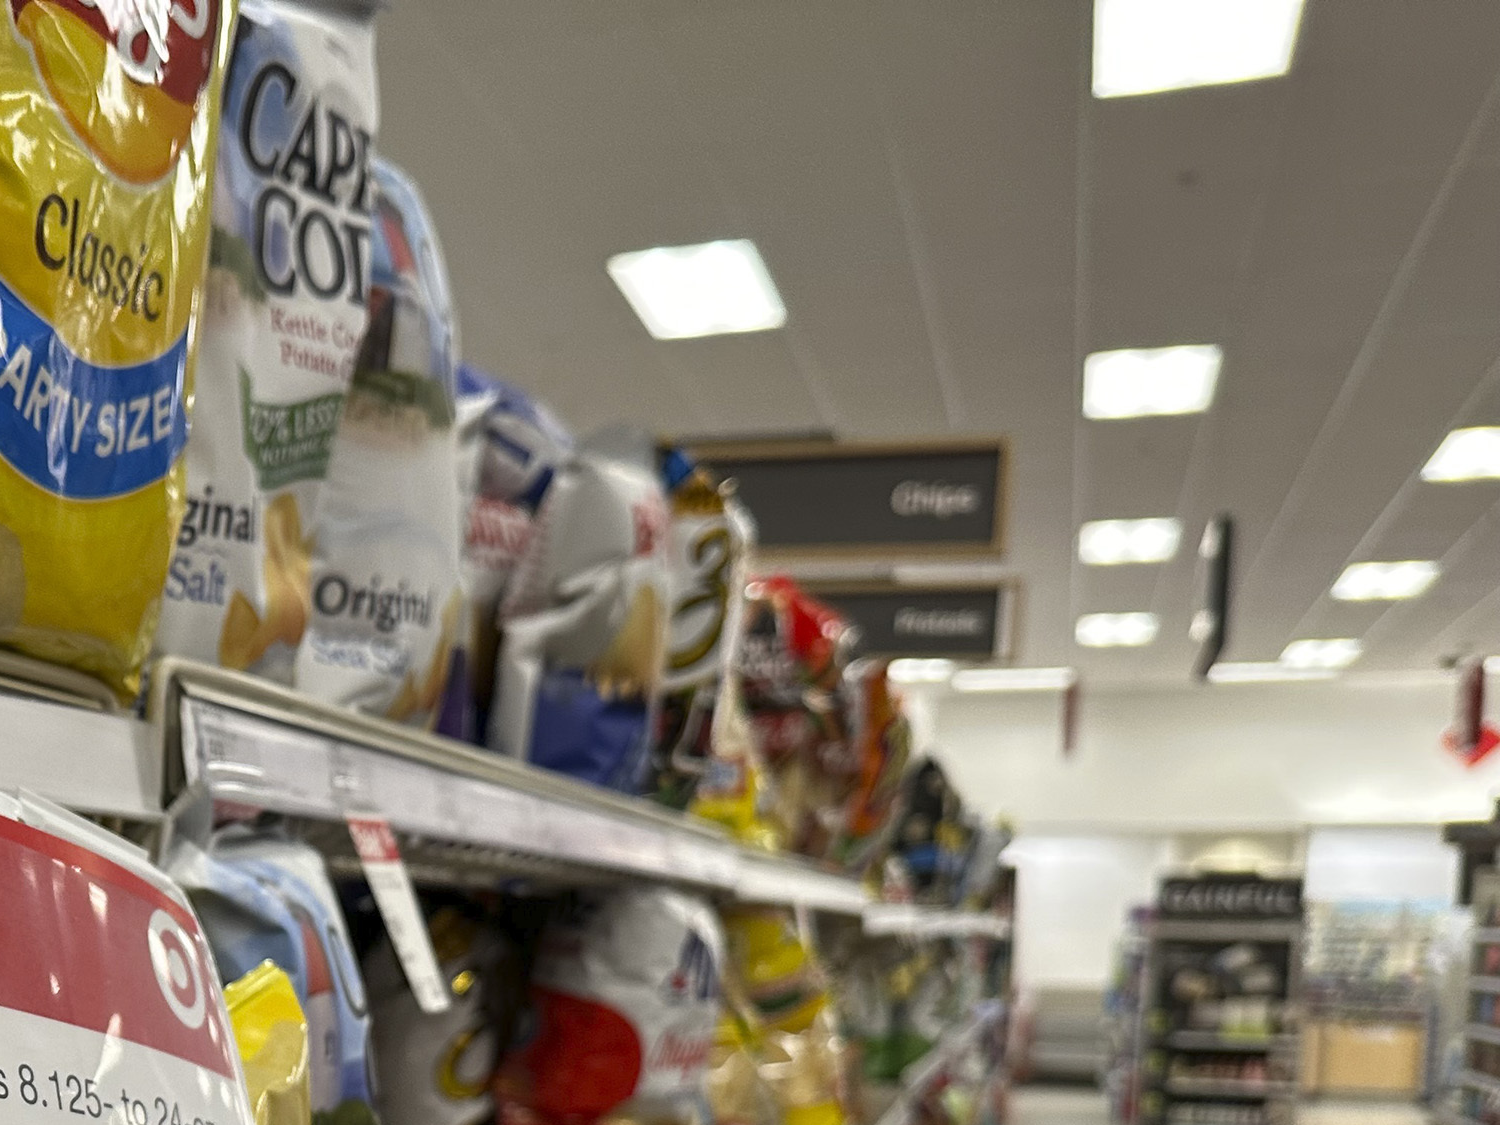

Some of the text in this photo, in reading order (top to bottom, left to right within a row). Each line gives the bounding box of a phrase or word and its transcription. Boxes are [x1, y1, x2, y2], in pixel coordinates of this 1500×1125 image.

[35, 193, 164, 322] Classic
[95, 384, 173, 458] SIZE
[177, 484, 256, 548] ginal
[167, 556, 226, 606] Salt
[17, 1063, 115, 1118] 8.125-
